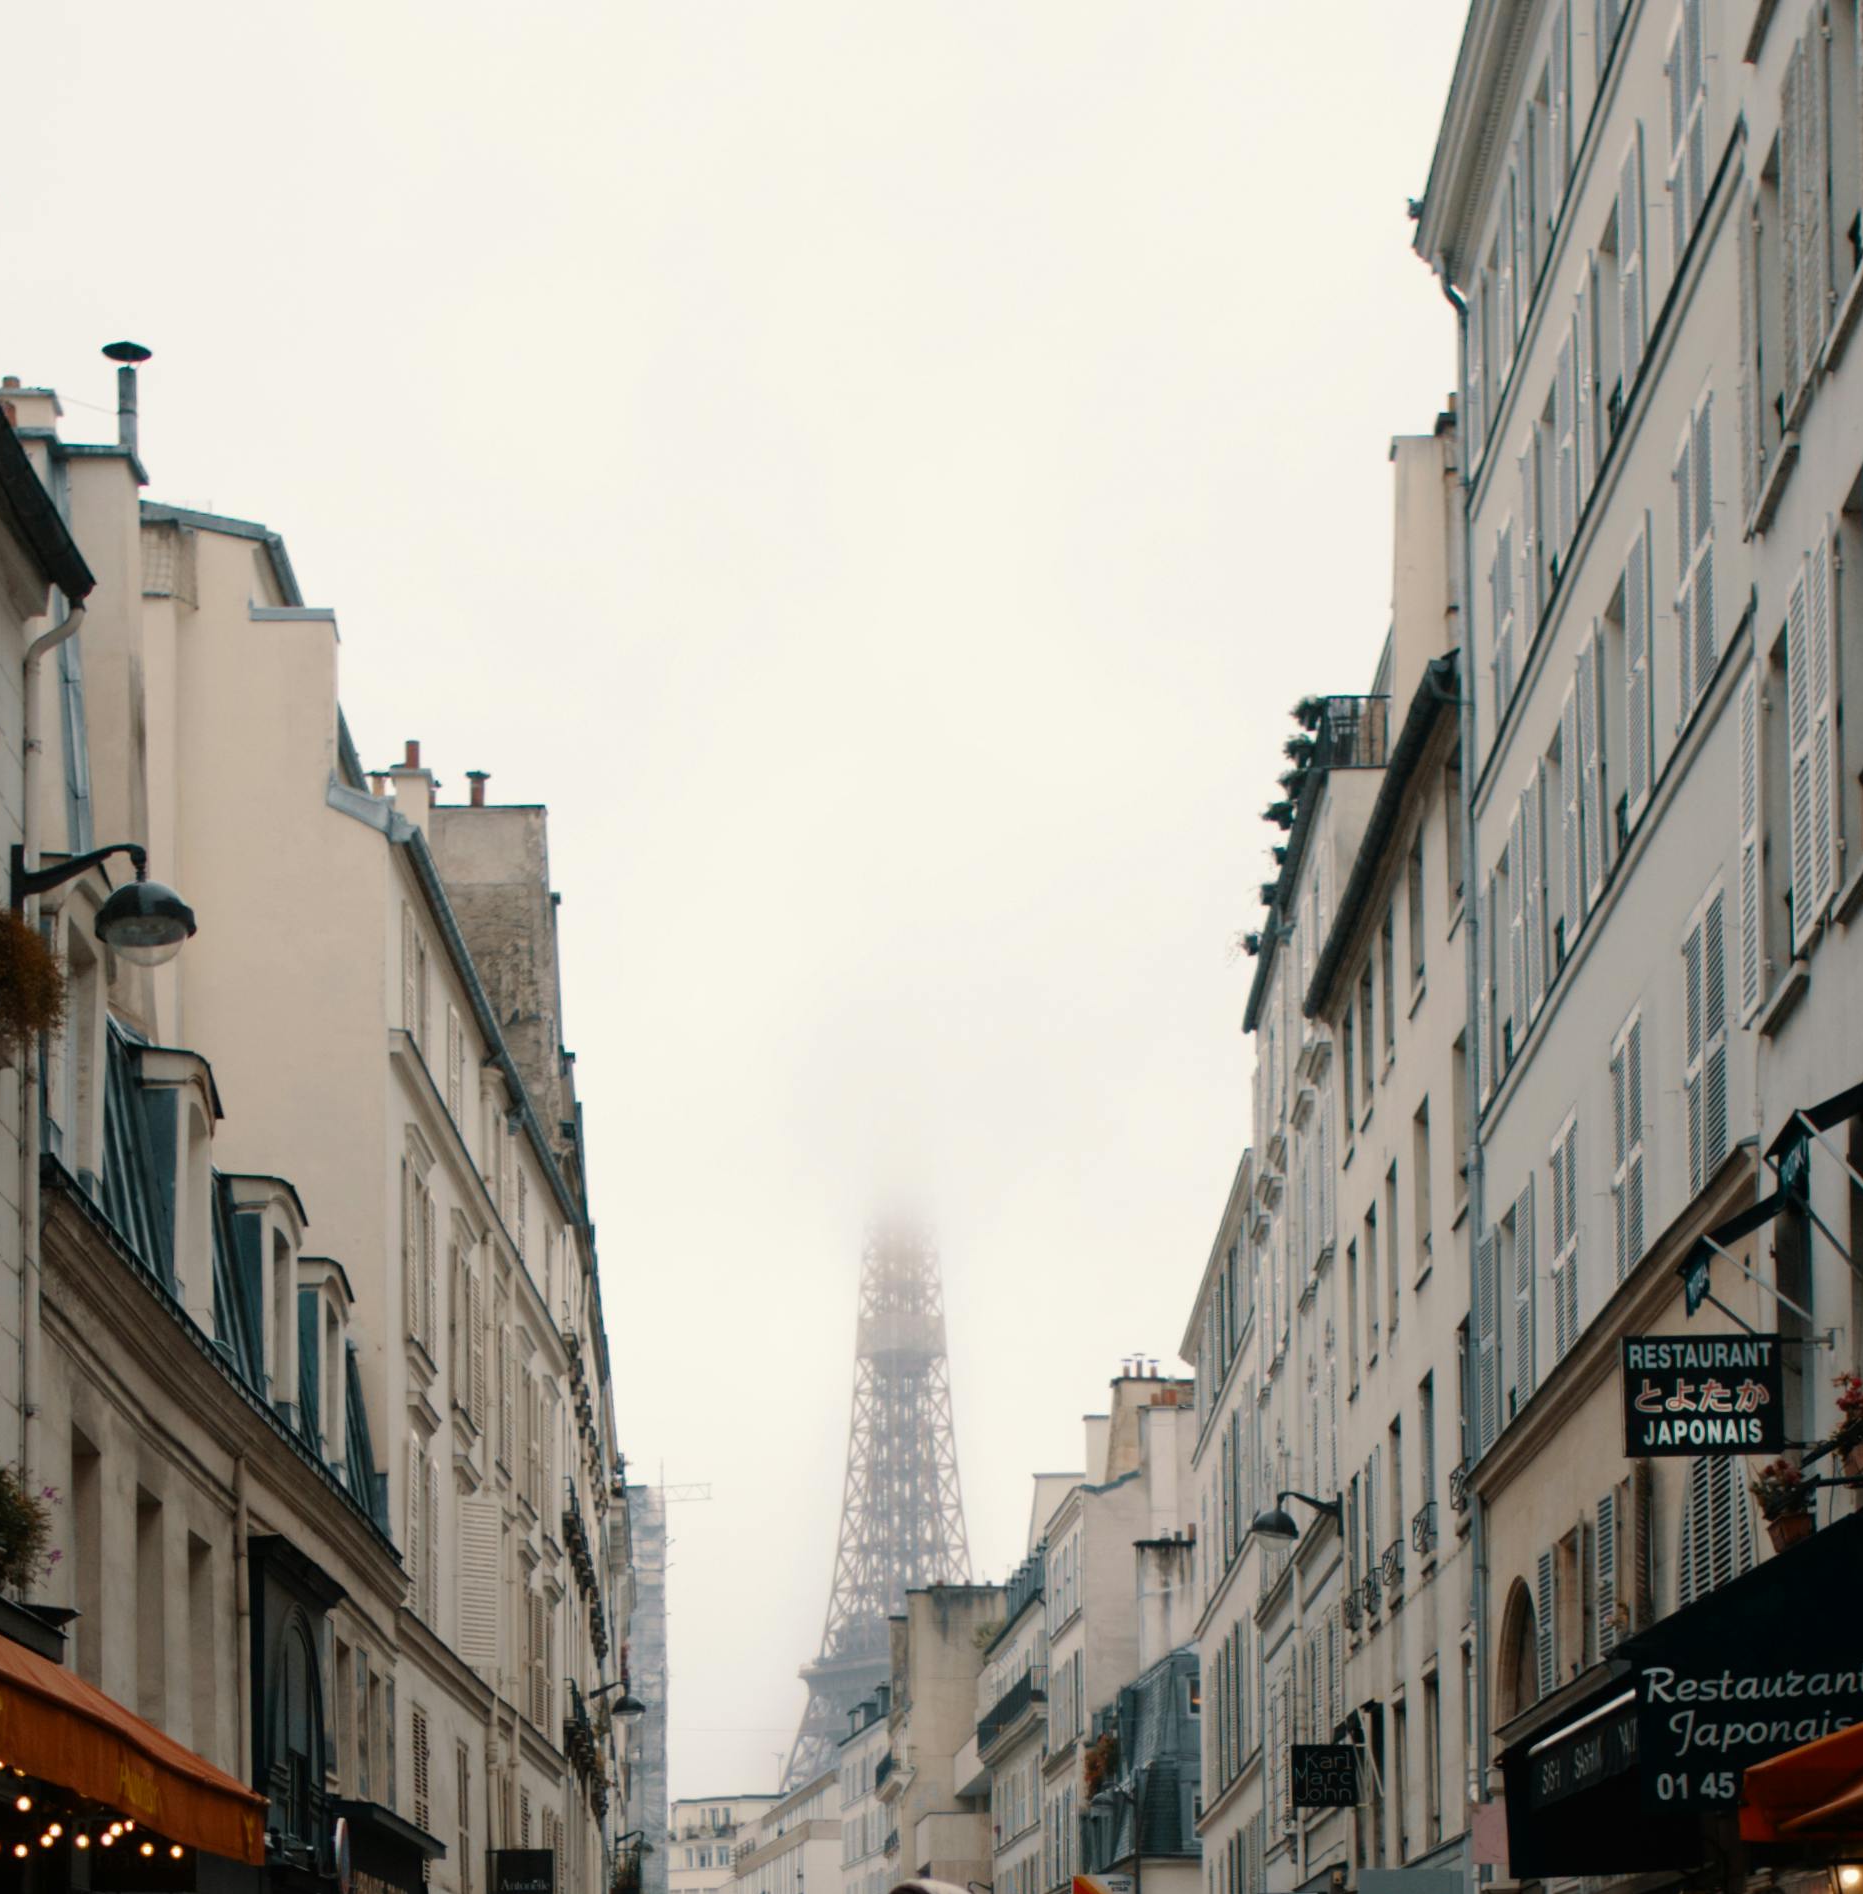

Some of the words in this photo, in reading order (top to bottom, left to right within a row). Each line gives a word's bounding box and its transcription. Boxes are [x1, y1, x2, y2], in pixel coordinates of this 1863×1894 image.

[1628, 1341, 1773, 1370] RESTAURANT
[1634, 1377, 1771, 1414] とよたか
[1643, 1417, 1763, 1446] JAPONAIS
[1304, 1751, 1353, 1769] Karl
[1295, 1767, 1353, 1785] Marc
[1656, 1772, 1688, 1801] 01
[1699, 1771, 1736, 1799] 45
[1296, 1784, 1353, 1802] John
